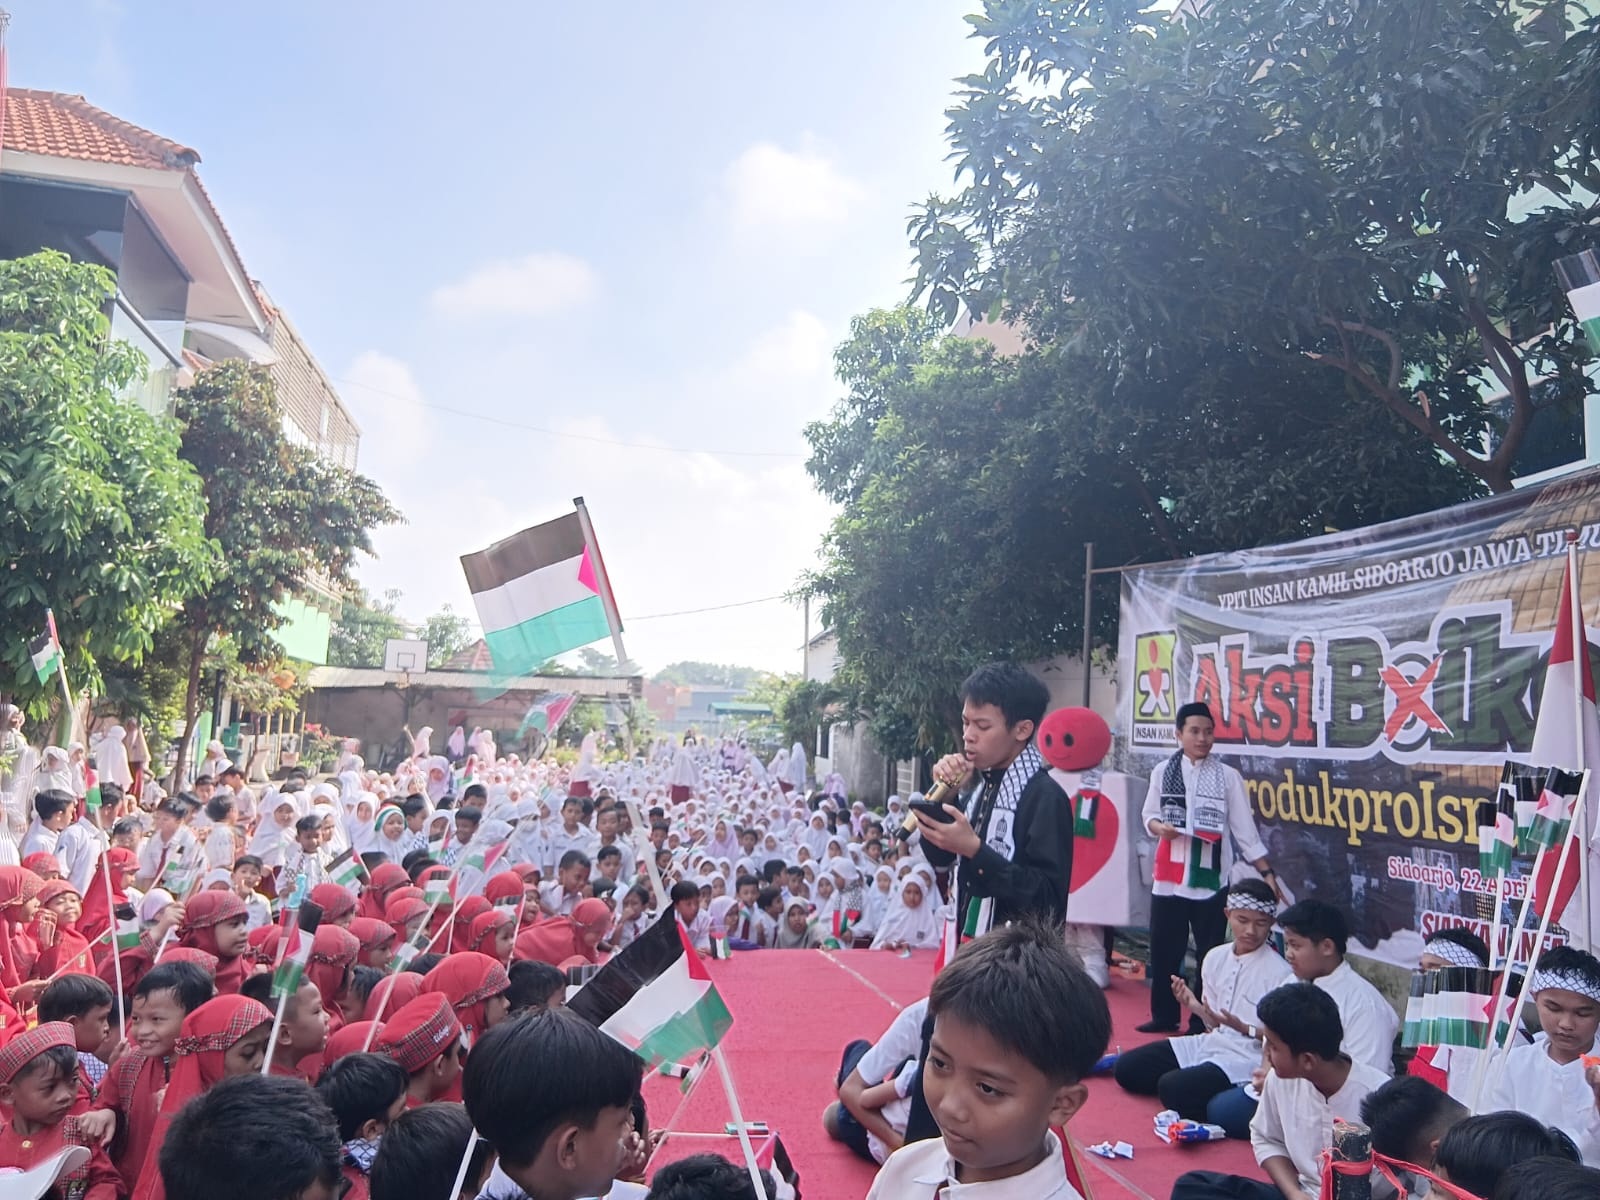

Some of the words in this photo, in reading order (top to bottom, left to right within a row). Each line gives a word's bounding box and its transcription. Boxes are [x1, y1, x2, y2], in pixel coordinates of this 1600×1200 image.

[1218, 591, 1248, 612] YPIT
[1250, 581, 1294, 608] INSAN
[1297, 572, 1350, 600] KAMIL
[1353, 551, 1455, 590] SIDOARJO
[1458, 536, 1531, 573] JAWA
[1196, 636, 1318, 747] Aksi
[1326, 613, 1600, 754] Boik
[1135, 727, 1157, 739] INSAN
[1388, 857, 1460, 892] Sidoarjo,
[1462, 868, 1482, 891] 22
